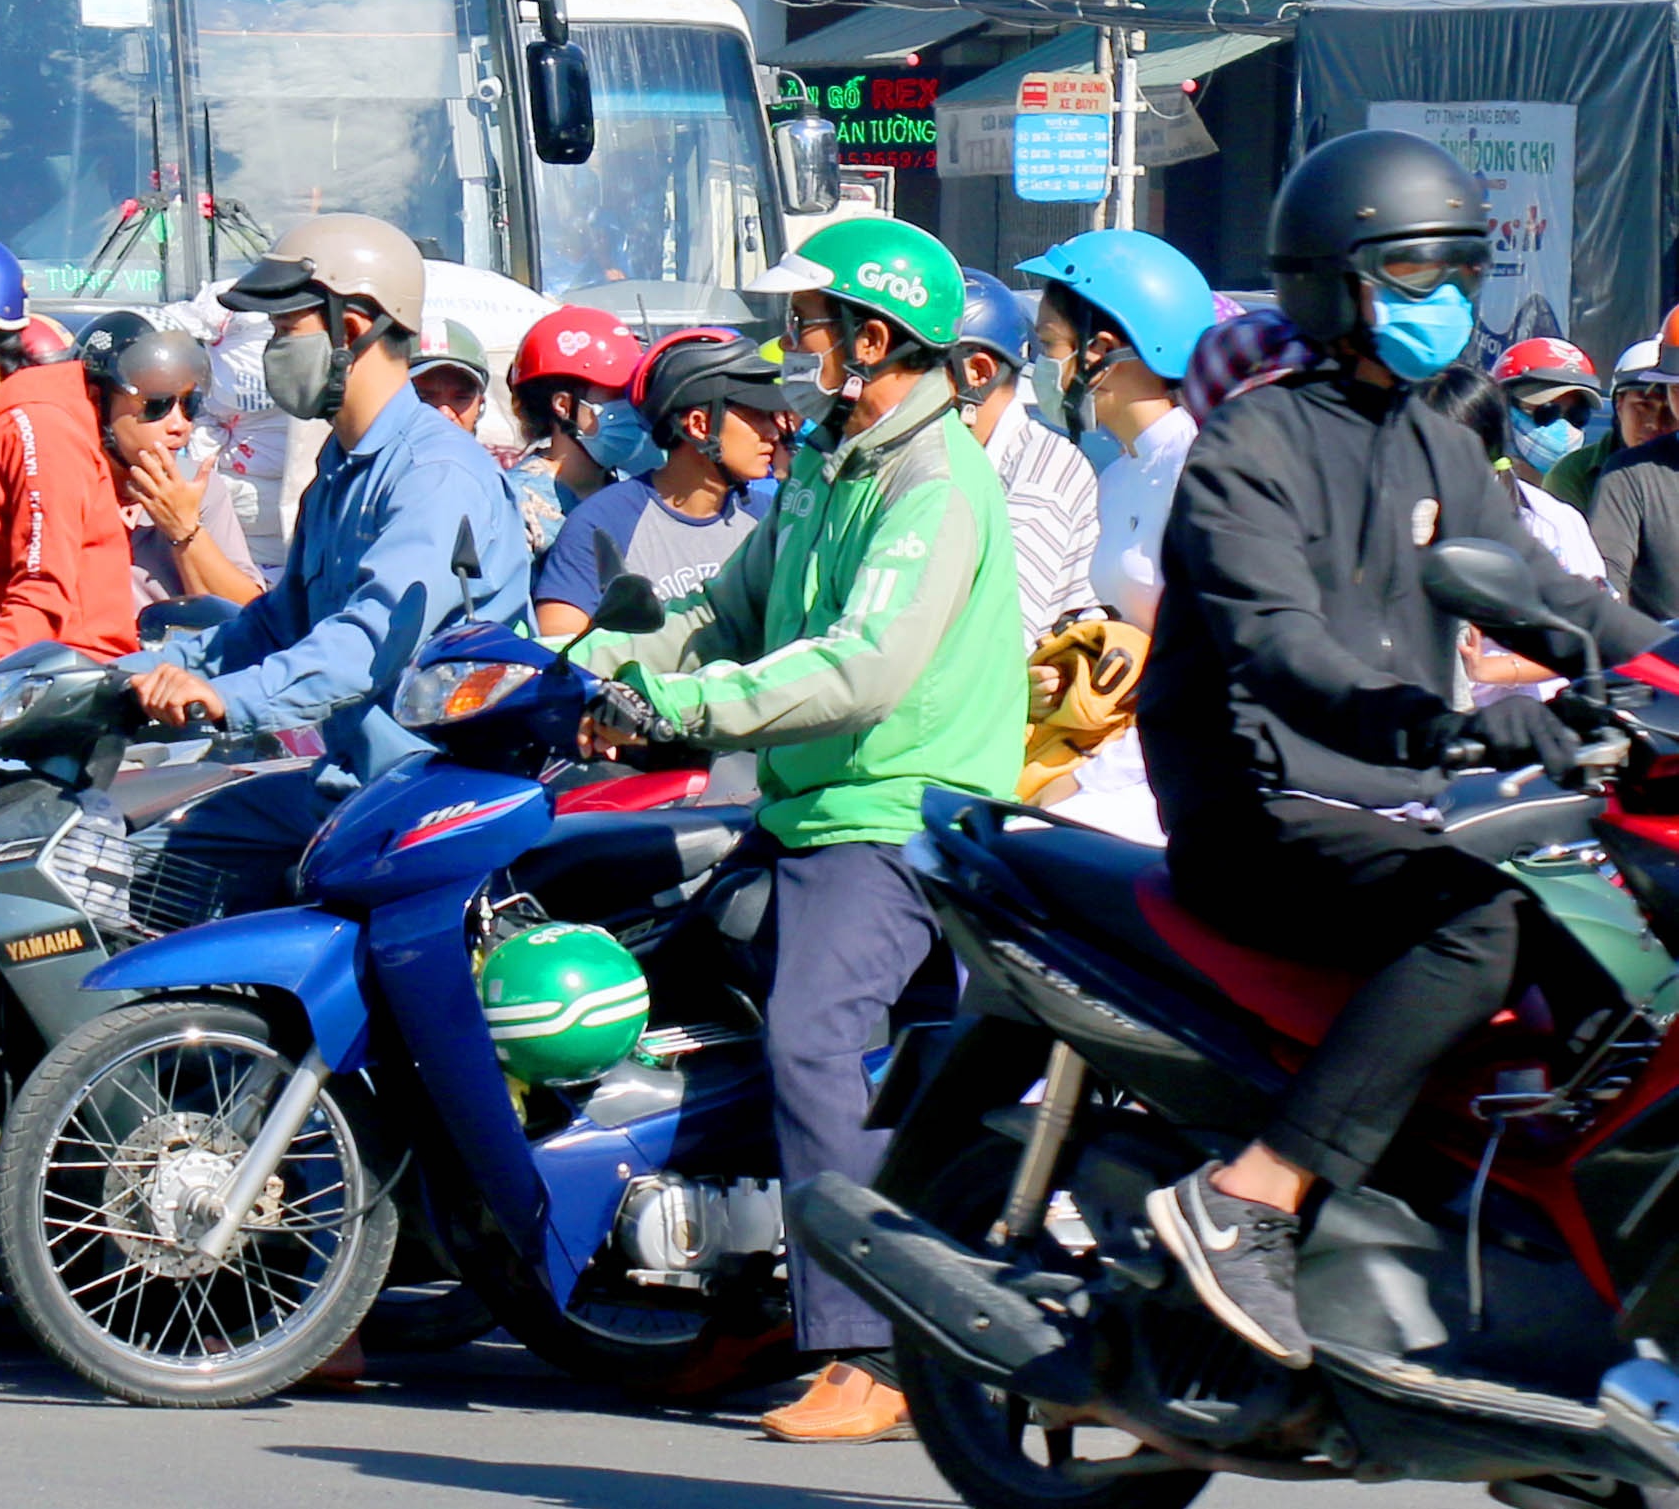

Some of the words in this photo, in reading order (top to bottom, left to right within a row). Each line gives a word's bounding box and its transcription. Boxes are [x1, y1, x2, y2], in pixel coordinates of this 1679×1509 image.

[871, 77, 940, 110] REX
[869, 113, 938, 143] TƯỜNG
[44, 263, 118, 292] TÙNG
[122, 268, 162, 291] VIP
[856, 260, 929, 308] Grab
[26, 511, 45, 580] BROOKLY
[416, 800, 478, 830] 110
[5, 927, 84, 962] YAMAHA
